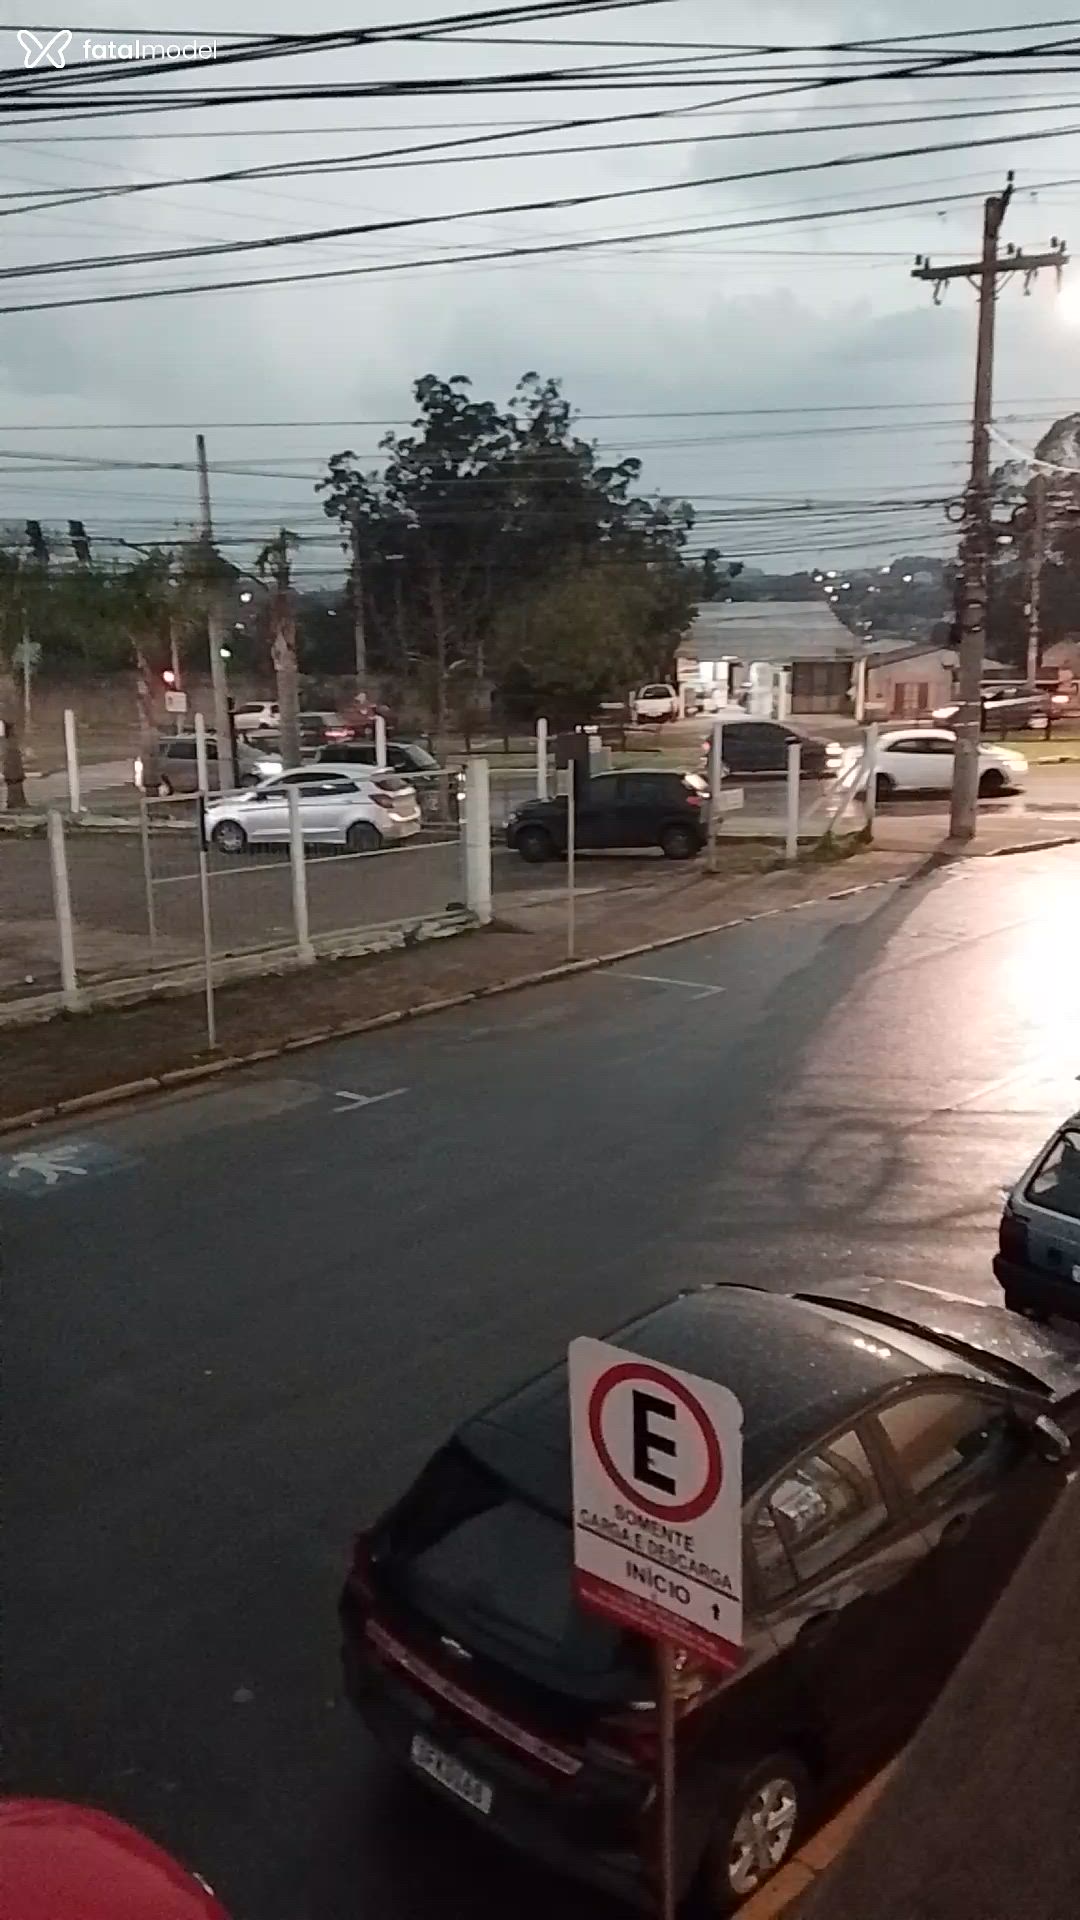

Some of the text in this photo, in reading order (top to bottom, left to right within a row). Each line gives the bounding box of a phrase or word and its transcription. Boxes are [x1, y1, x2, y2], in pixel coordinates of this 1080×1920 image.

[632, 1389, 677, 1496] E
[580, 1509, 732, 1591] CARGA E DESCARGA
[613, 1504, 695, 1553] SOMENTE
[625, 1560, 691, 1605] INÍCIO
